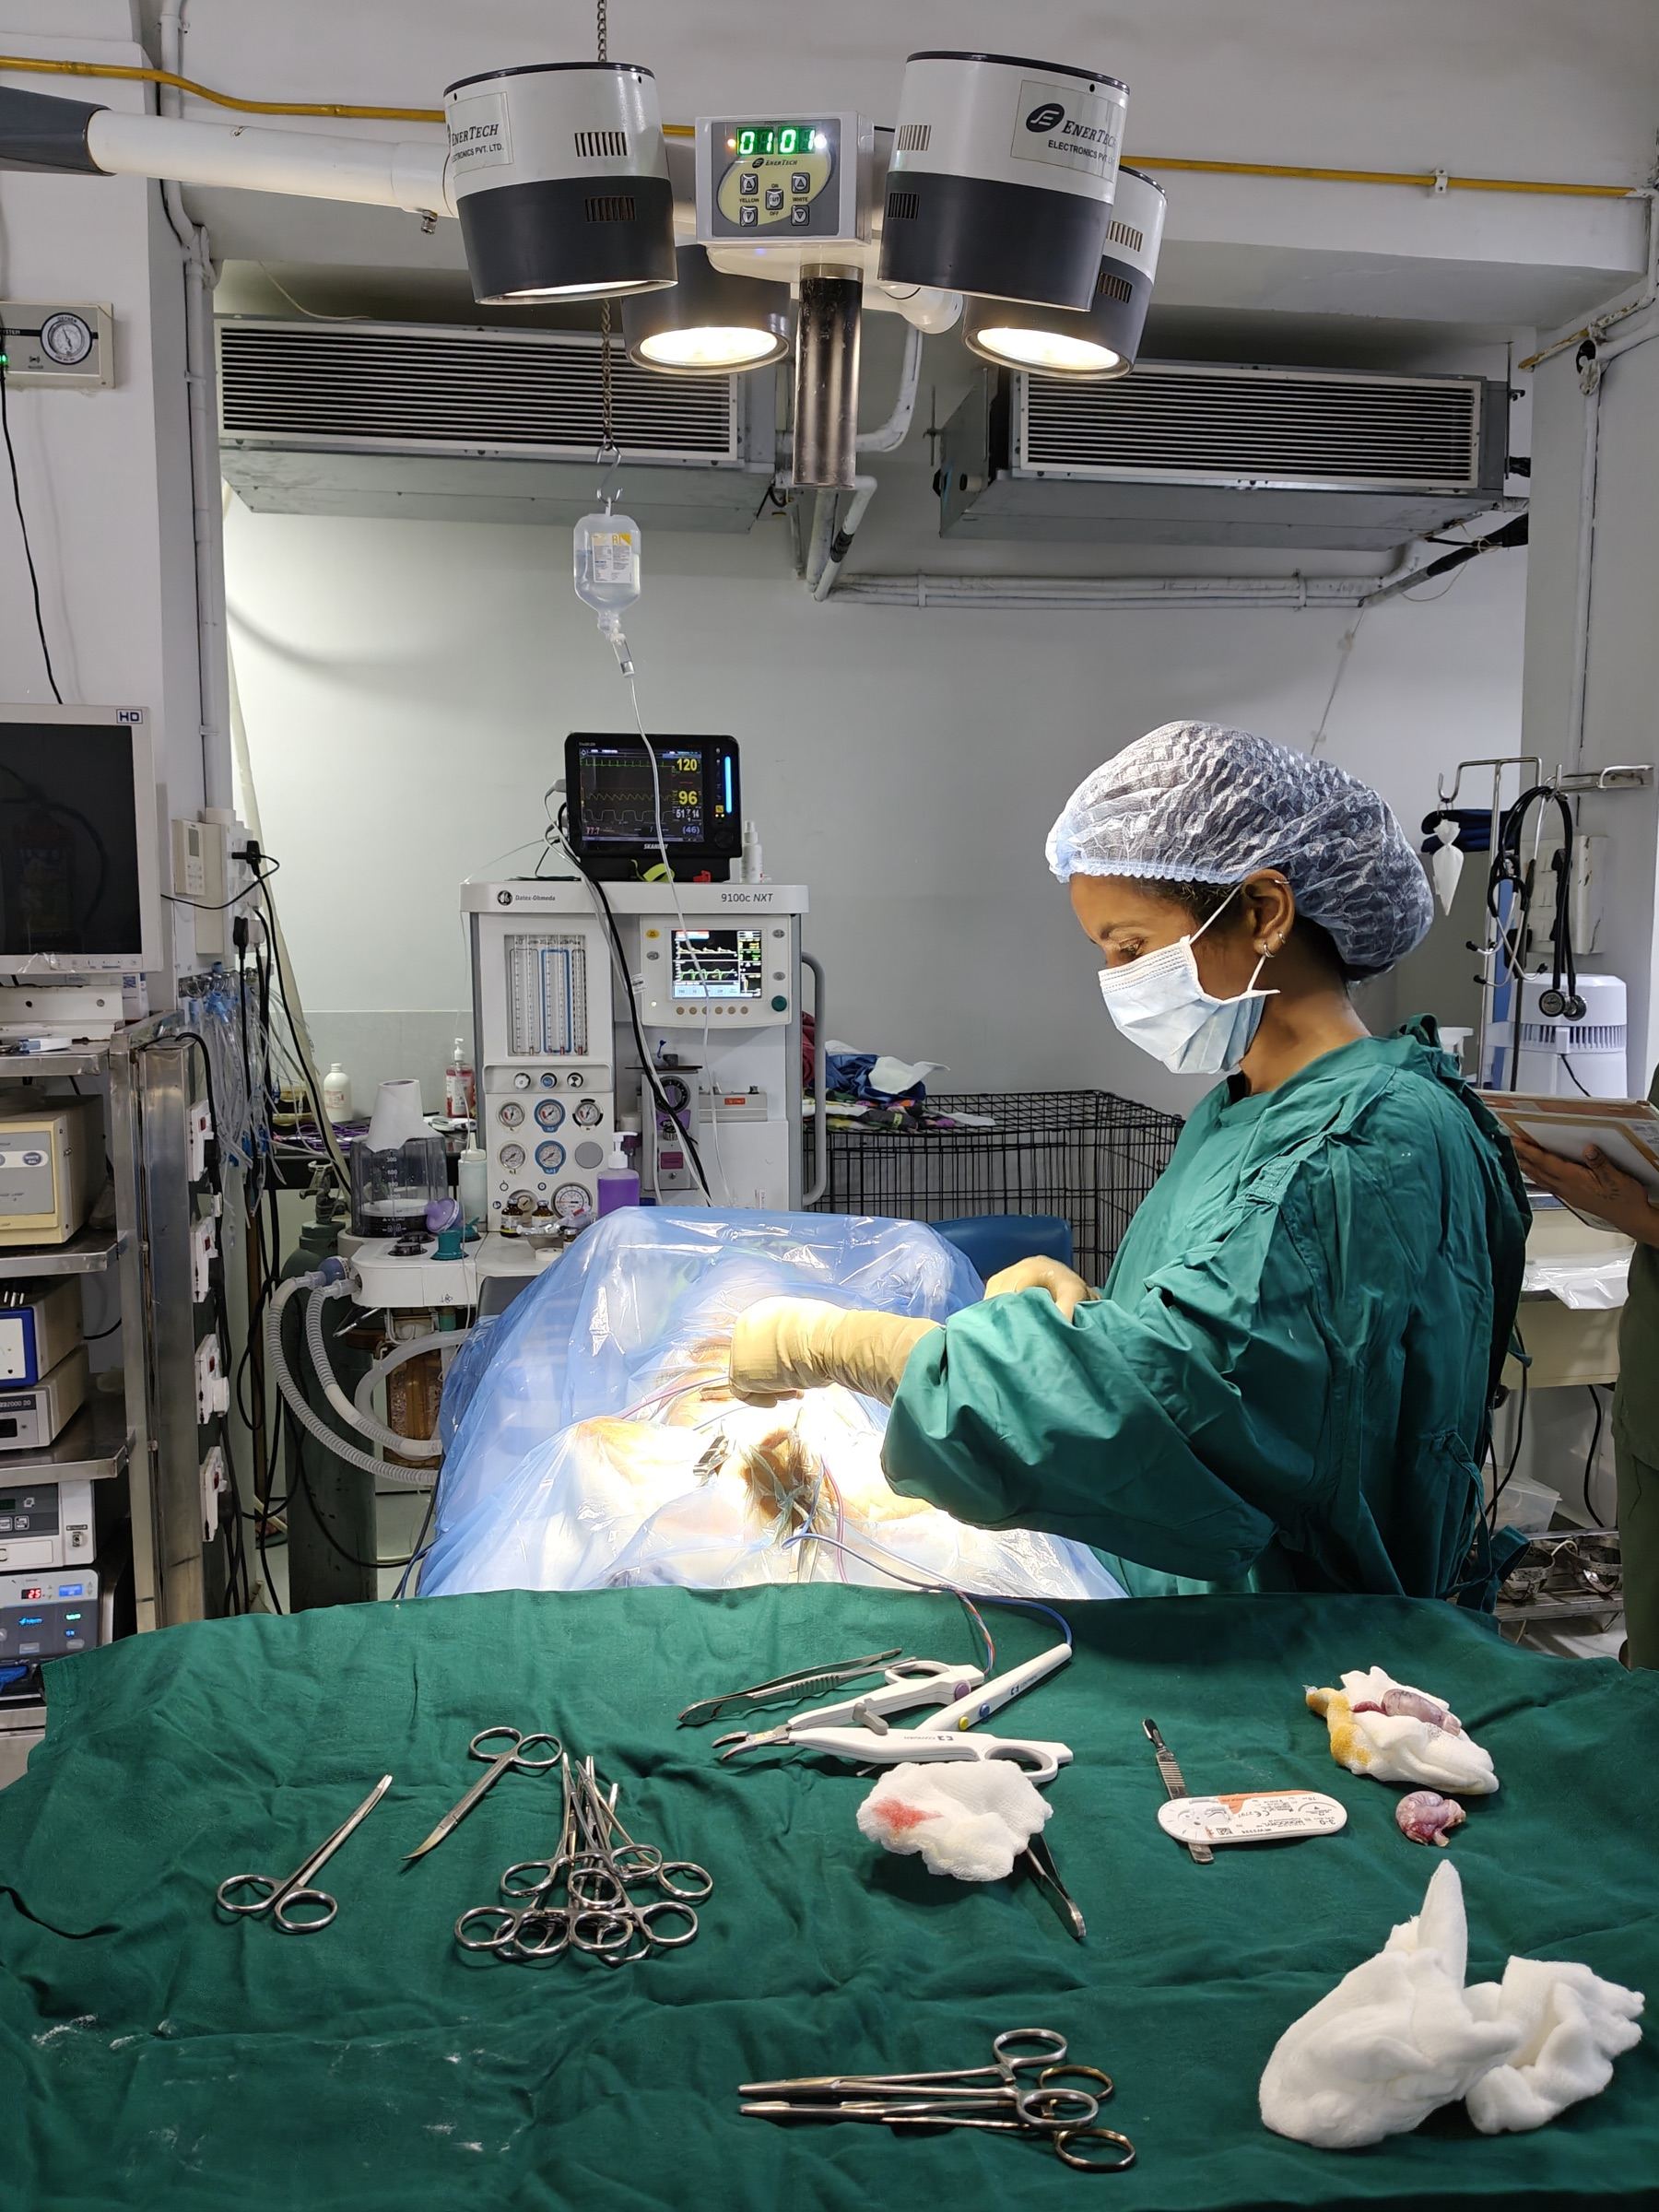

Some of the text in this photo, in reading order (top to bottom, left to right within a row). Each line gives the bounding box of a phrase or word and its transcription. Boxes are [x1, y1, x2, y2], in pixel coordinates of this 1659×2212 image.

[475, 146, 488, 155] PVT.
[489, 143, 504, 152] LTD.
[1048, 140, 1098, 159] ELECTRONICS
[119, 712, 139, 723] HD
[677, 758, 698, 771] 120
[678, 791, 698, 806] 96
[676, 809, 685, 818] 51
[682, 825, 700, 834] (46)
[721, 893, 774, 902] 9100c NXT
[28, 1589, 41, 1599] 25
